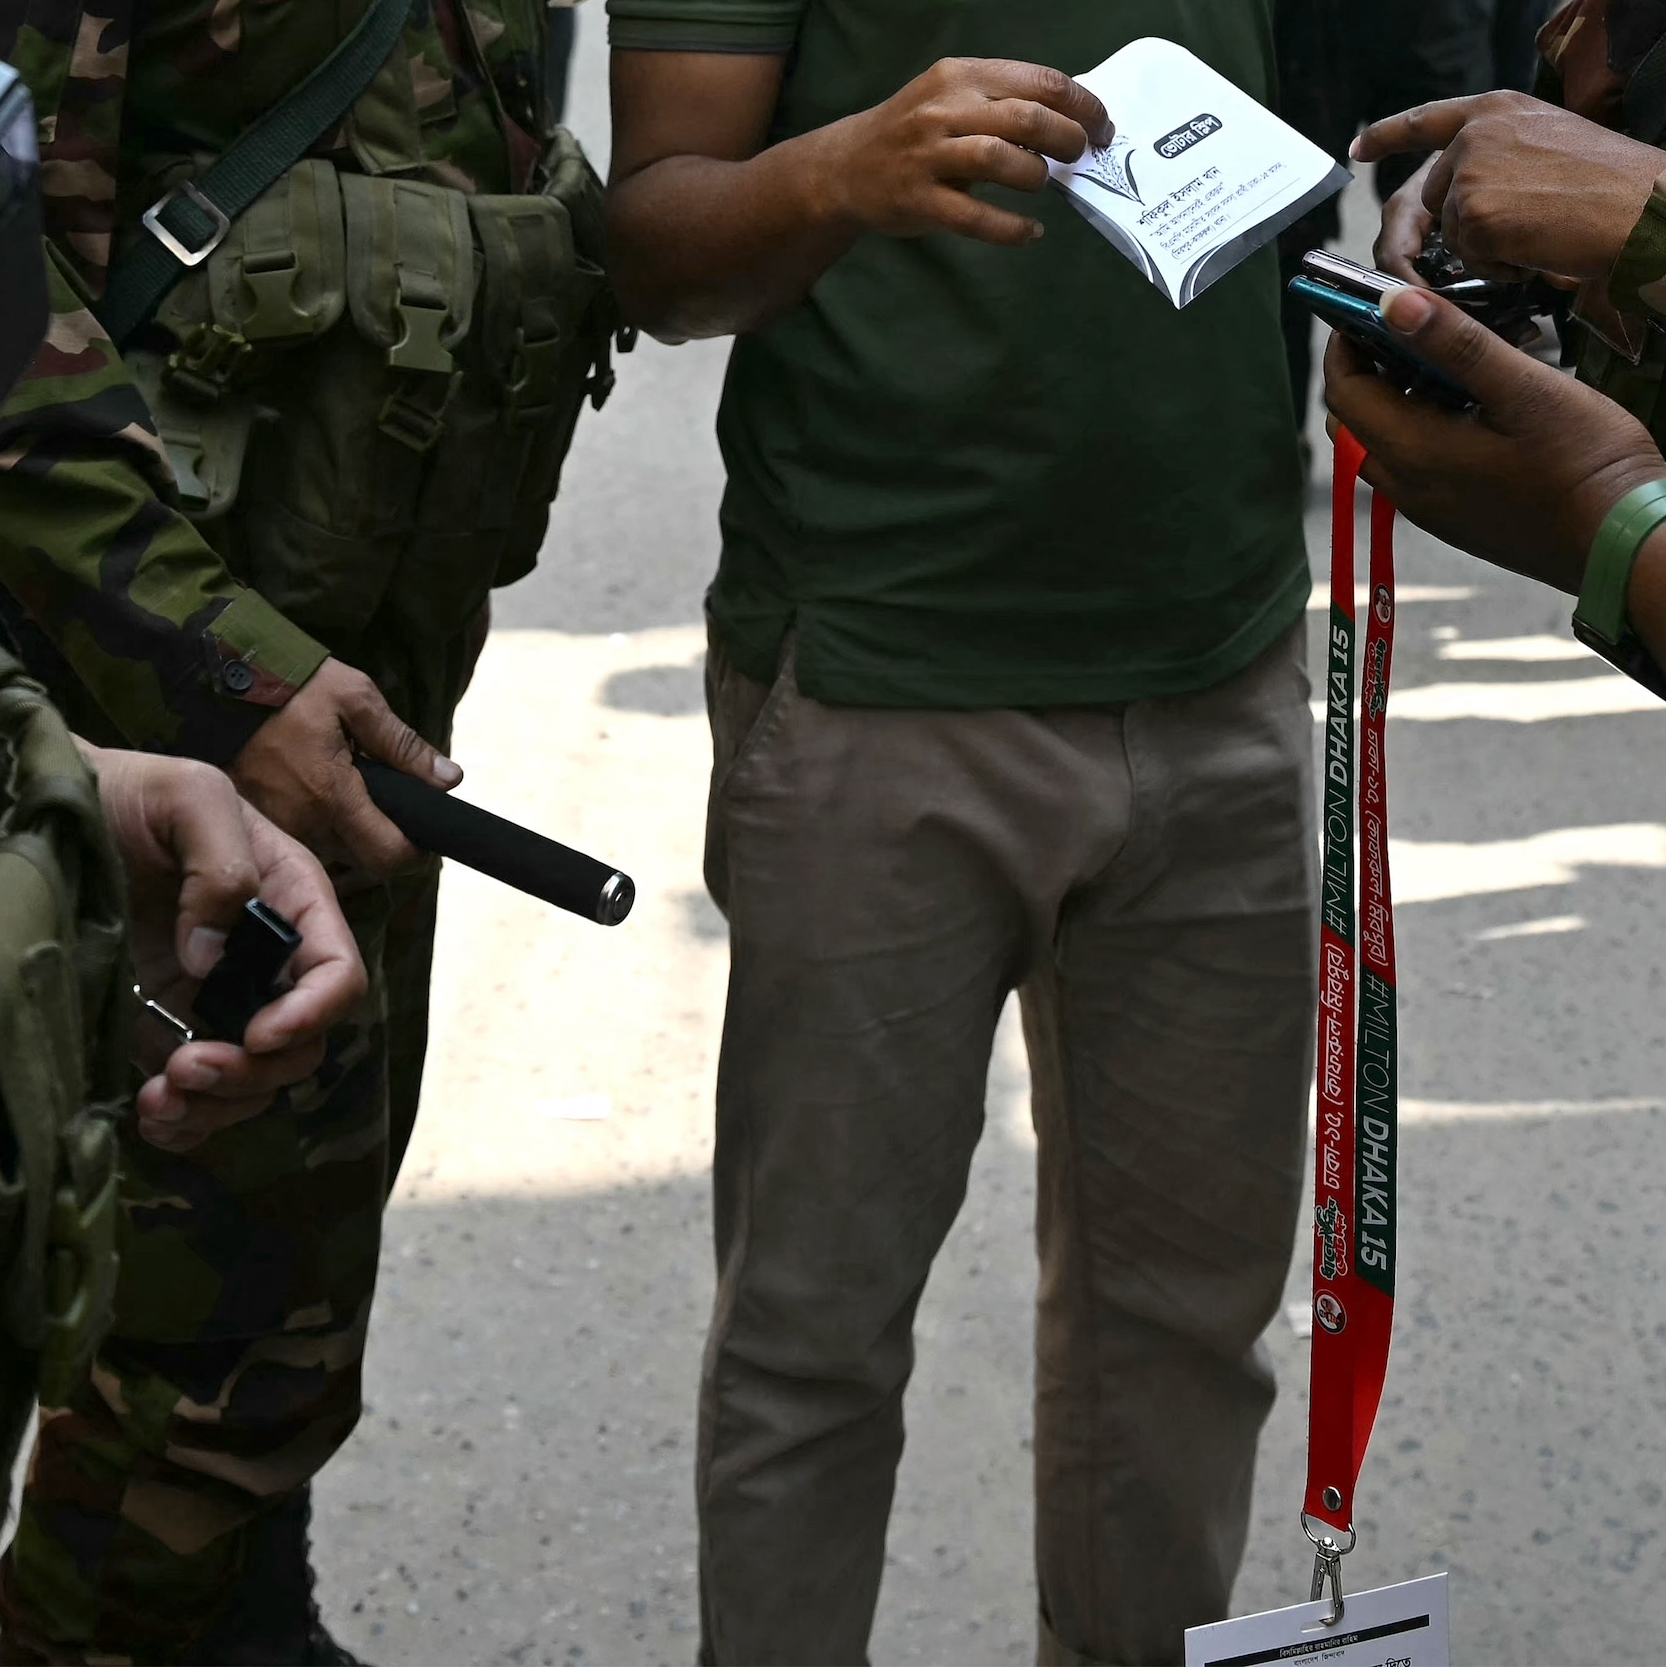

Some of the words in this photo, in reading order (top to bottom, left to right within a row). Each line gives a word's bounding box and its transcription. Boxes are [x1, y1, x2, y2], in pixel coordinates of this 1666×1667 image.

[1161, 131, 1197, 157] ভোটার
[1137, 199, 1174, 225] শফিকুল
[1169, 177, 1204, 201] ইসলাম
[1203, 166, 1221, 180] খান
[1333, 625, 1349, 667] 15
[1329, 672, 1348, 786] DHAKA
[1364, 728, 1380, 804] ঢাকা-১৫,
[1326, 789, 1349, 935] #MILTON
[1364, 809, 1389, 967] (কাফরুল-মিরপুর)
[1321, 942, 1349, 1106] (কাফরুল-মিরপুর)
[1363, 974, 1390, 1113] #MILTON
[1323, 1111, 1344, 1189] ঢাকা-১৫,
[1362, 1115, 1389, 1227] DHAKA
[1360, 1230, 1387, 1272] 15
